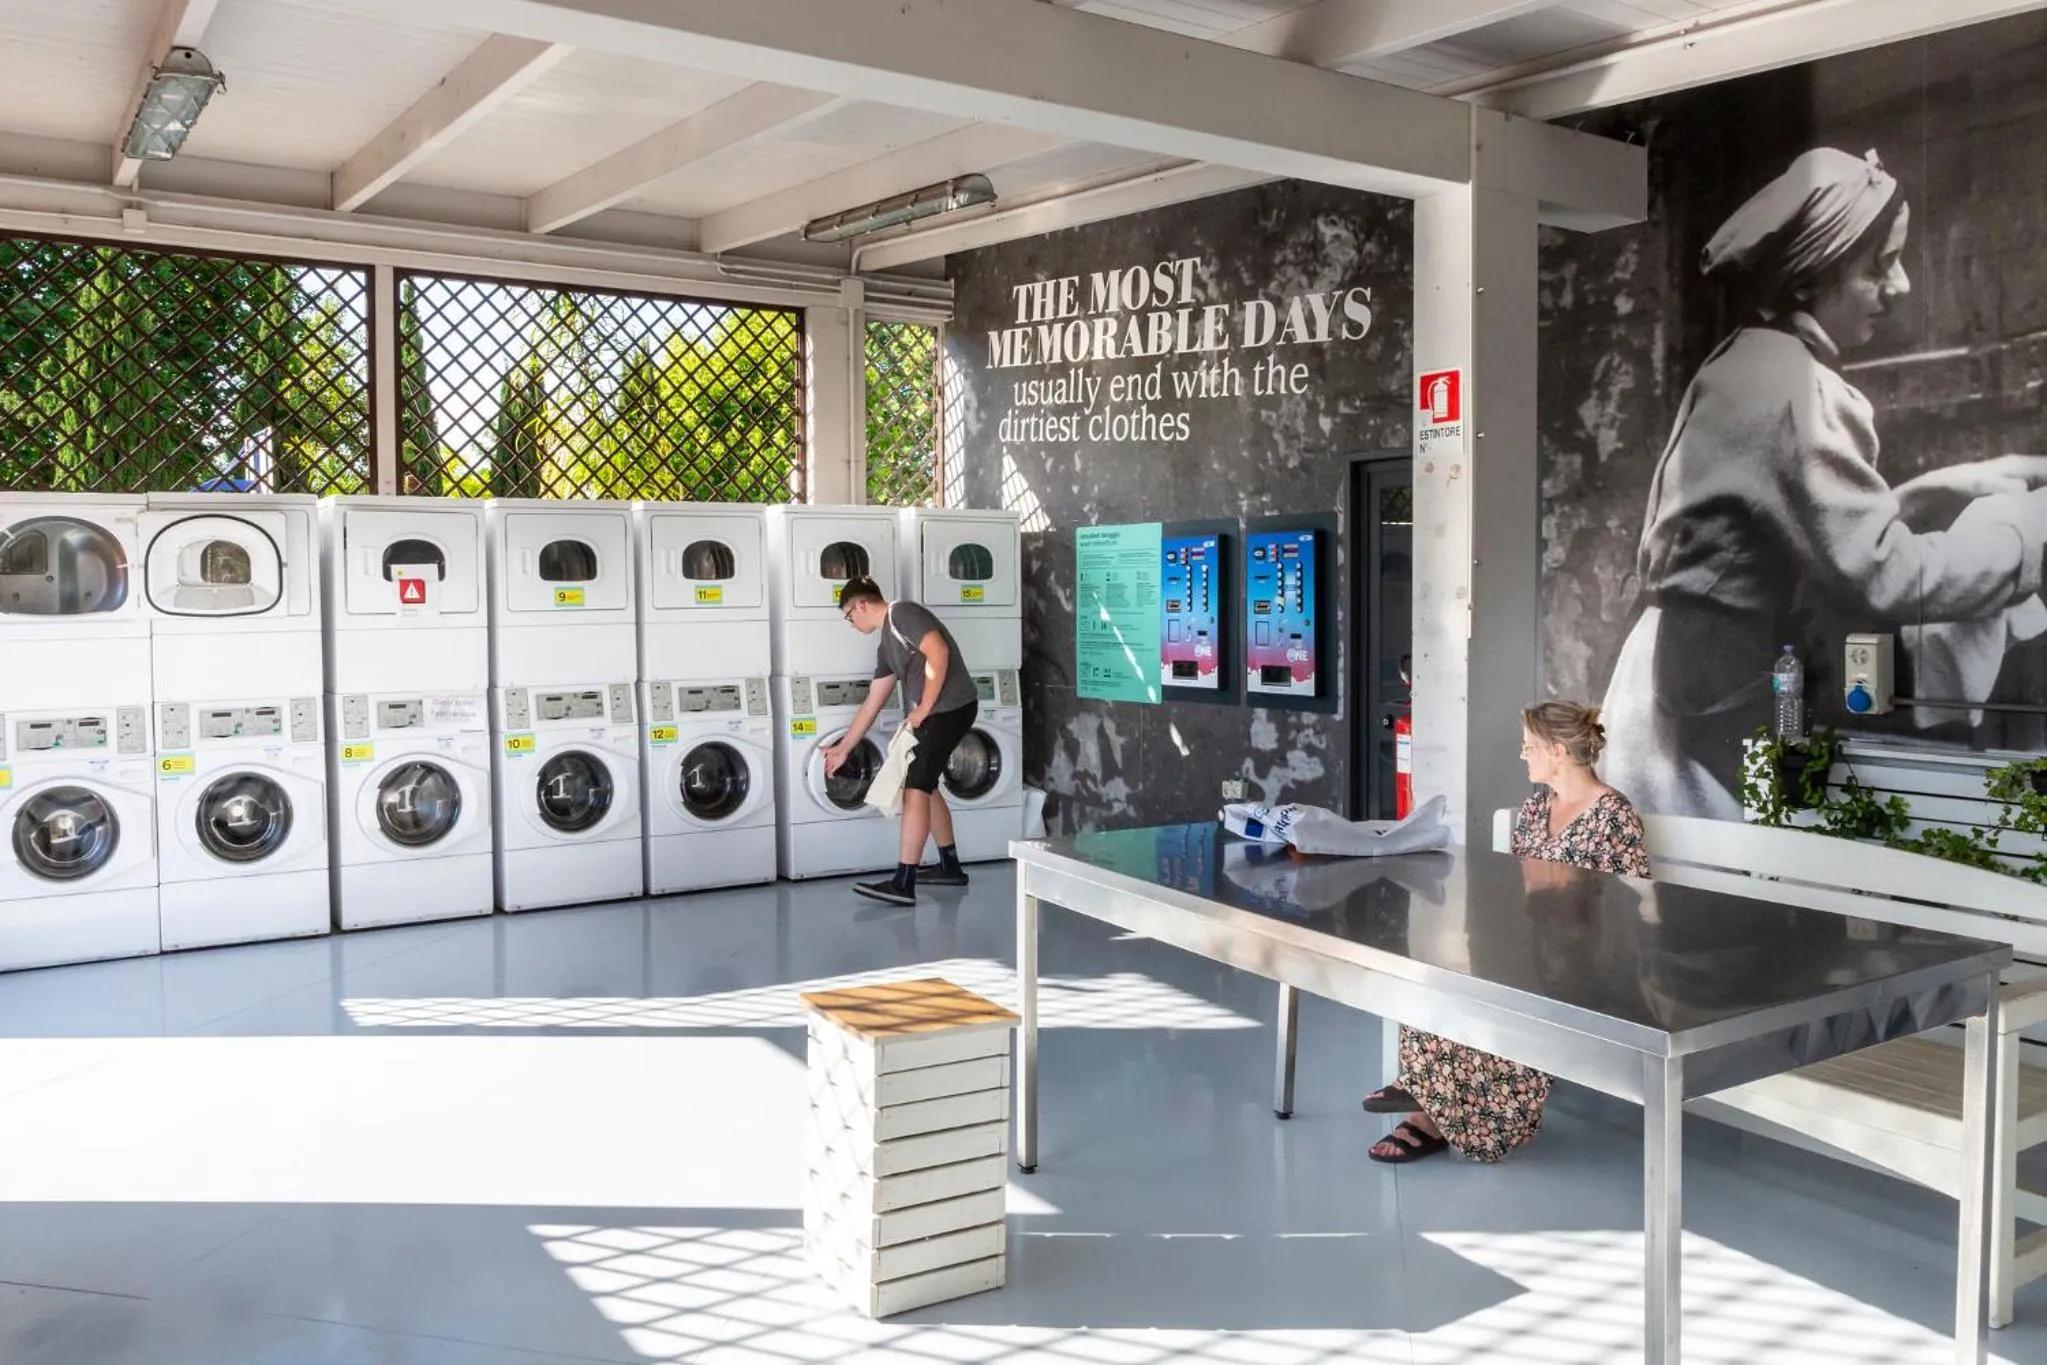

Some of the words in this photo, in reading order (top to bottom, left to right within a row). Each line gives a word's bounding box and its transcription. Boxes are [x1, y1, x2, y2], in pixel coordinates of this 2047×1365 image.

[1012, 275, 1079, 324] THE
[1087, 257, 1201, 316] MOST
[986, 304, 1229, 369] MEMORABLE
[1240, 287, 1372, 348] DAYS
[1013, 367, 1101, 415] usually
[1109, 364, 1162, 402] end
[1172, 357, 1241, 399] with
[1253, 353, 1309, 396] the
[998, 408, 1080, 443] dirtiest
[1088, 403, 1190, 442] clothes
[1419, 426, 1461, 441] ESTINTORE
[558, 591, 566, 602] 9
[698, 589, 707, 600] 11
[792, 722, 804, 732] 14
[652, 729, 664, 739] 12
[508, 739, 521, 749] 10
[344, 747, 353, 758] 8
[162, 759, 172, 771] 6
